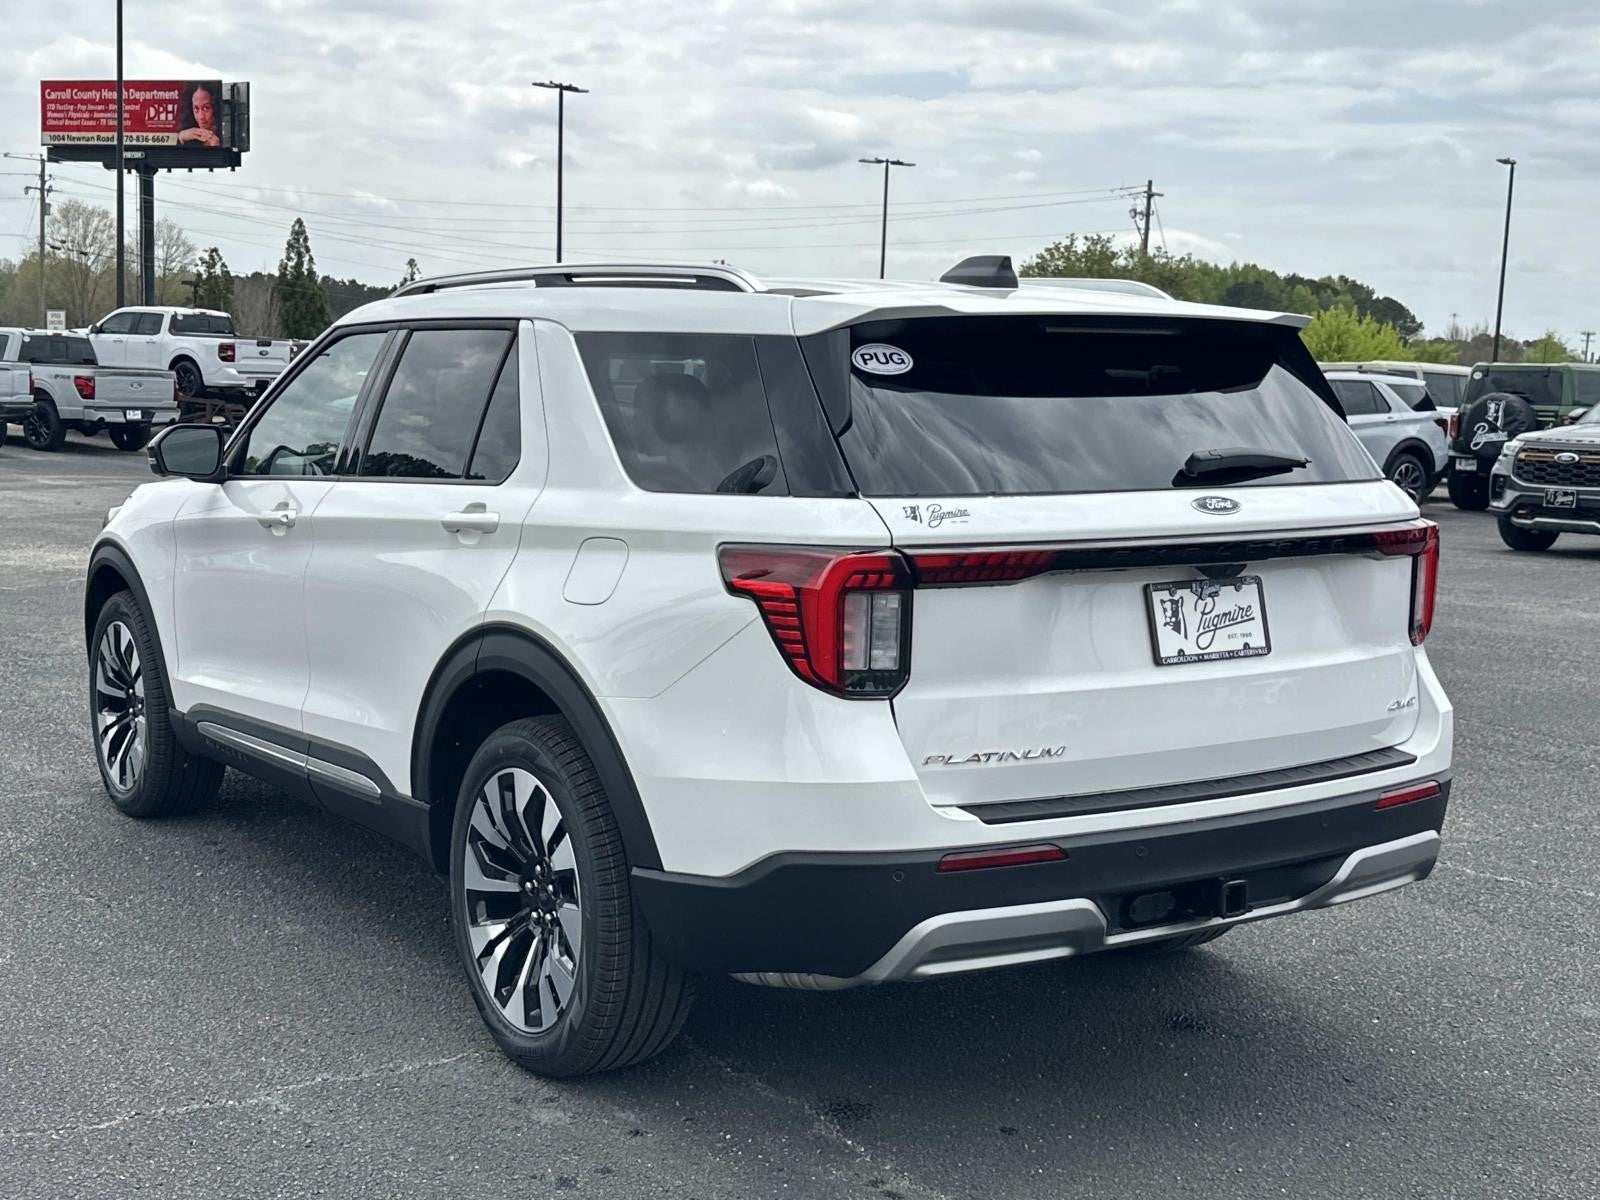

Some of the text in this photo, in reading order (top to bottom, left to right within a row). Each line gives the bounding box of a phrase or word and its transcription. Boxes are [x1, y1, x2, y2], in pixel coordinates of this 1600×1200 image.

[45, 88, 179, 102] Carroll County Heah Department
[48, 134, 170, 143] 1004 Newnan Road 70-836-6667
[859, 351, 907, 366] PUG
[1206, 498, 1233, 509] Ford
[926, 503, 971, 528] Pugmire
[1194, 596, 1256, 651] Pugmire
[1203, 651, 1230, 660] MARIETTA
[1233, 646, 1269, 657] CARTERSVILLE
[922, 745, 1067, 766] PLATINUM
